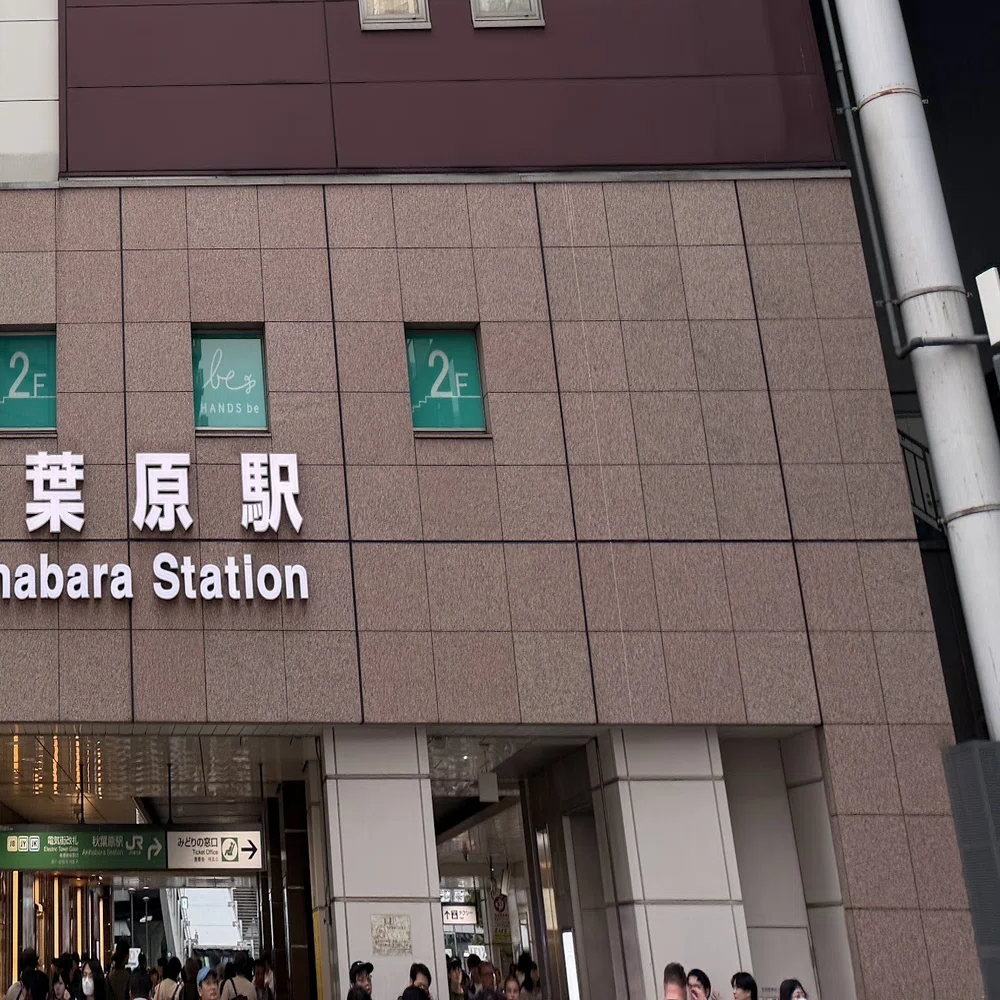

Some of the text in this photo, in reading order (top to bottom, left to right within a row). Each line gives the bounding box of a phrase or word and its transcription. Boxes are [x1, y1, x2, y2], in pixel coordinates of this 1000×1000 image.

[8, 351, 47, 398] 2F
[428, 350, 469, 398] 2F
[200, 403, 260, 414] HANDS be
[153, 551, 309, 601] Station
[125, 836, 144, 850] JR
[177, 837, 218, 848] みどりの窓口
